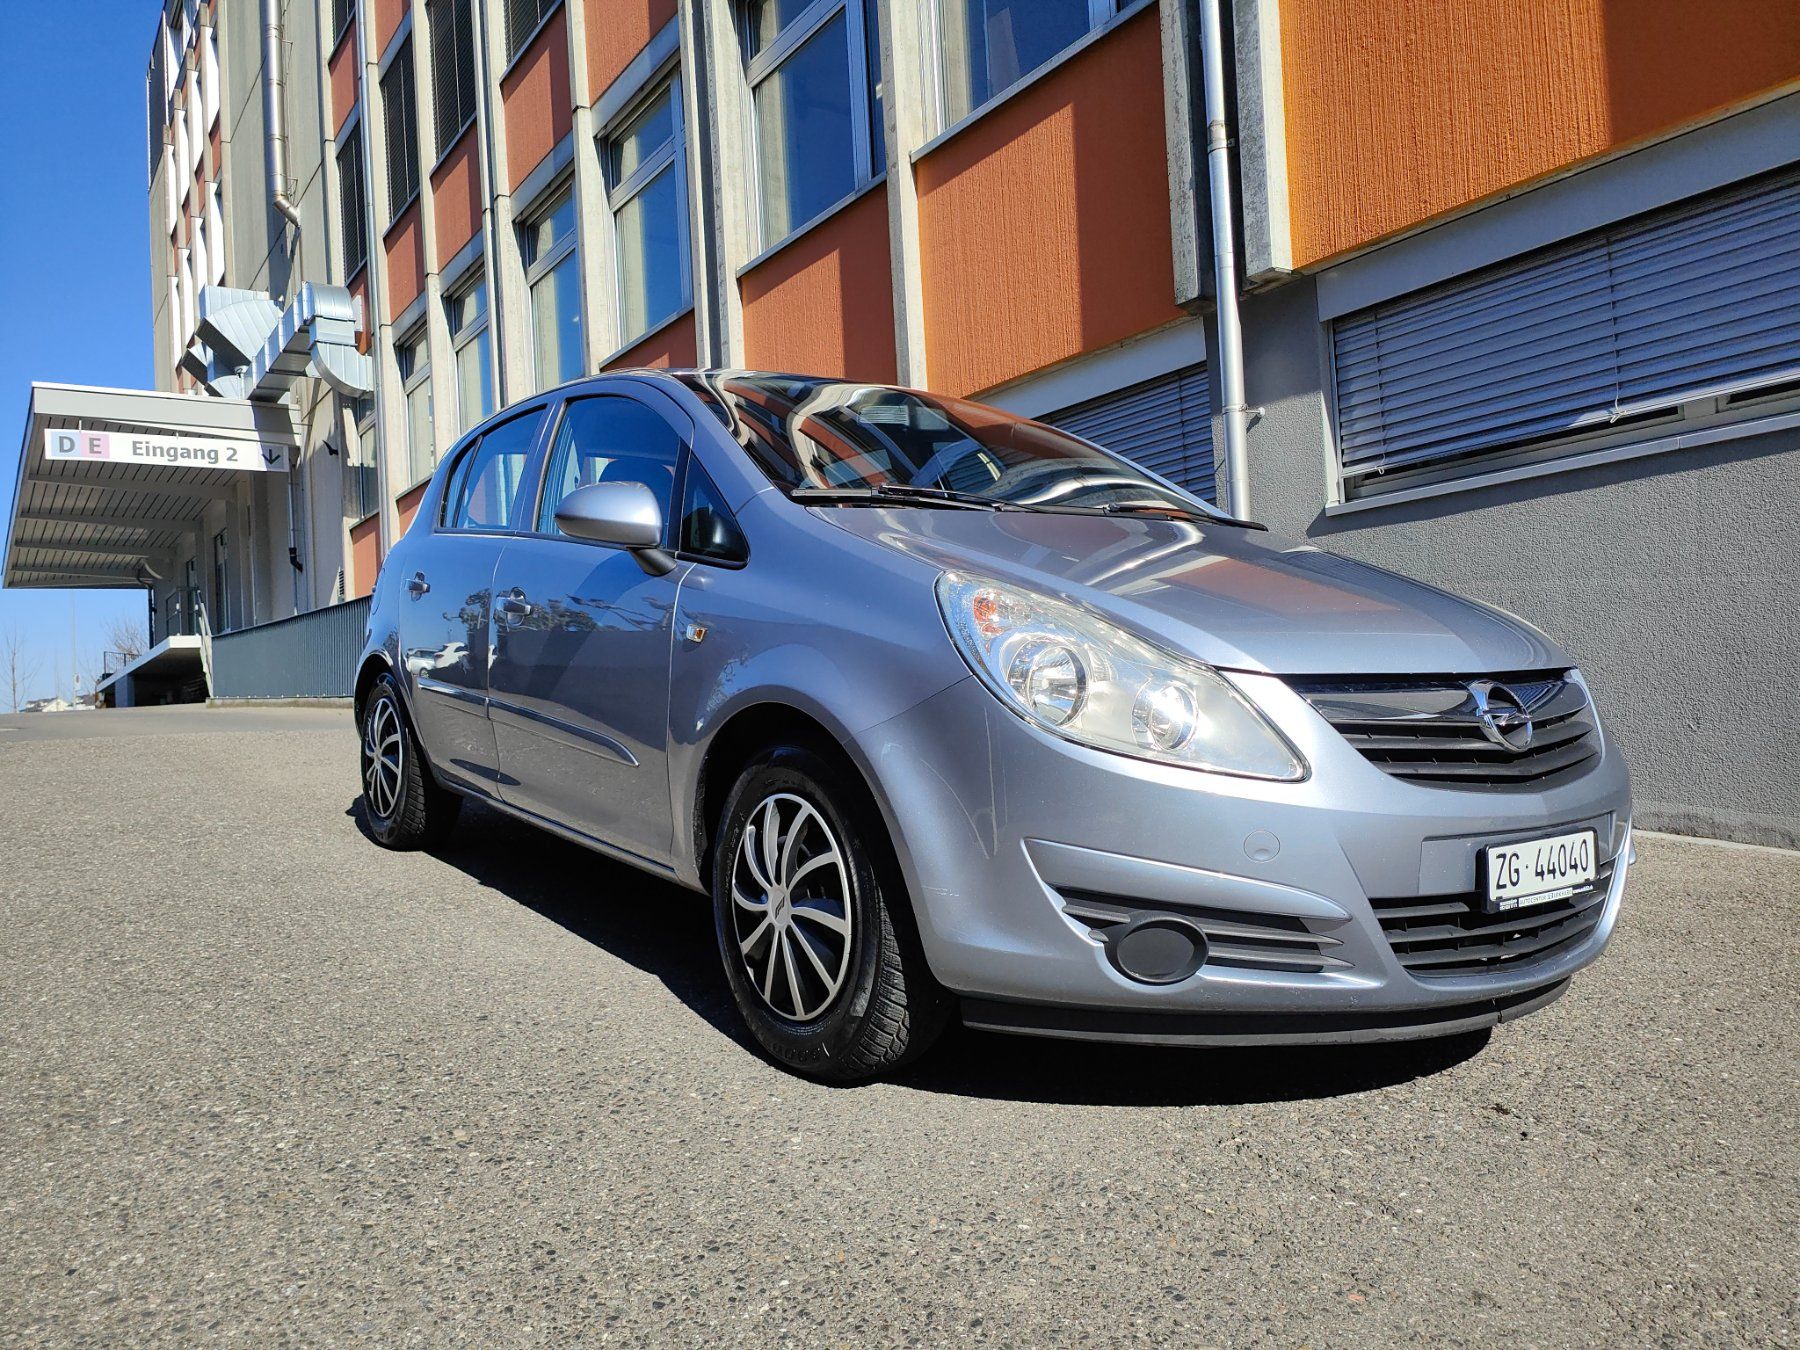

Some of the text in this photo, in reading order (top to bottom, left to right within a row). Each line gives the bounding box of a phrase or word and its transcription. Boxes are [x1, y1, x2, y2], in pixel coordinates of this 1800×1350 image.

[58, 435, 238, 465] D E Eingang 2
[1534, 838, 1589, 882] 44040
